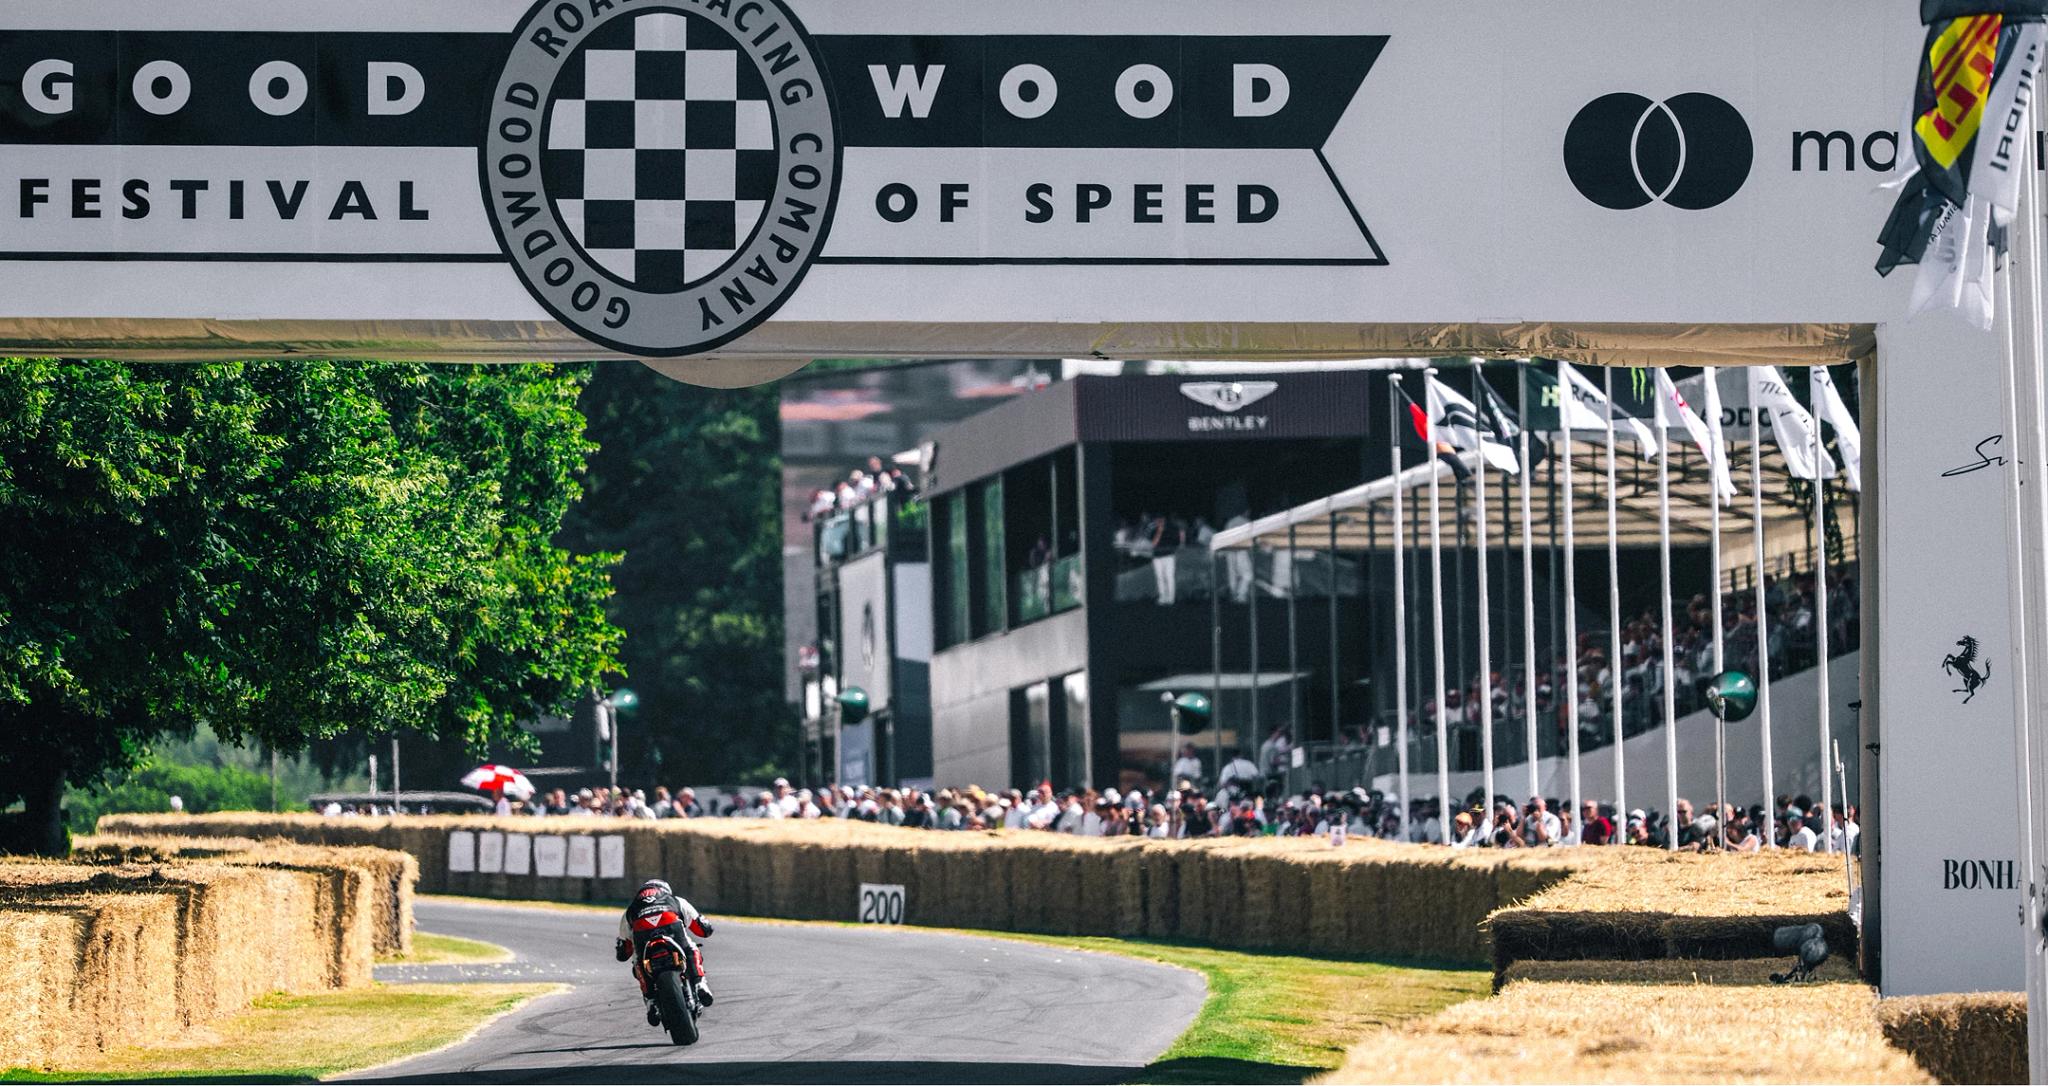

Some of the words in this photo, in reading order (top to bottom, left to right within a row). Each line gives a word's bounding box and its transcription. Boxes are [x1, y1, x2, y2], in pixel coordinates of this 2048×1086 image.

[530, 0, 632, 59] ROA
[690, 0, 813, 106] ACING
[22, 59, 425, 115] GOOD
[867, 63, 1290, 119] WOOD
[1792, 130, 1899, 171] ma
[19, 178, 429, 221] FESTIVAL
[875, 182, 969, 224] OF
[1025, 182, 1280, 224] SPEED
[499, 82, 630, 329] GOODWOOD
[698, 133, 823, 330] COMPANY
[1188, 415, 1269, 431] BENTLEY
[1943, 859, 2022, 890] BONH
[863, 890, 902, 925] 200
